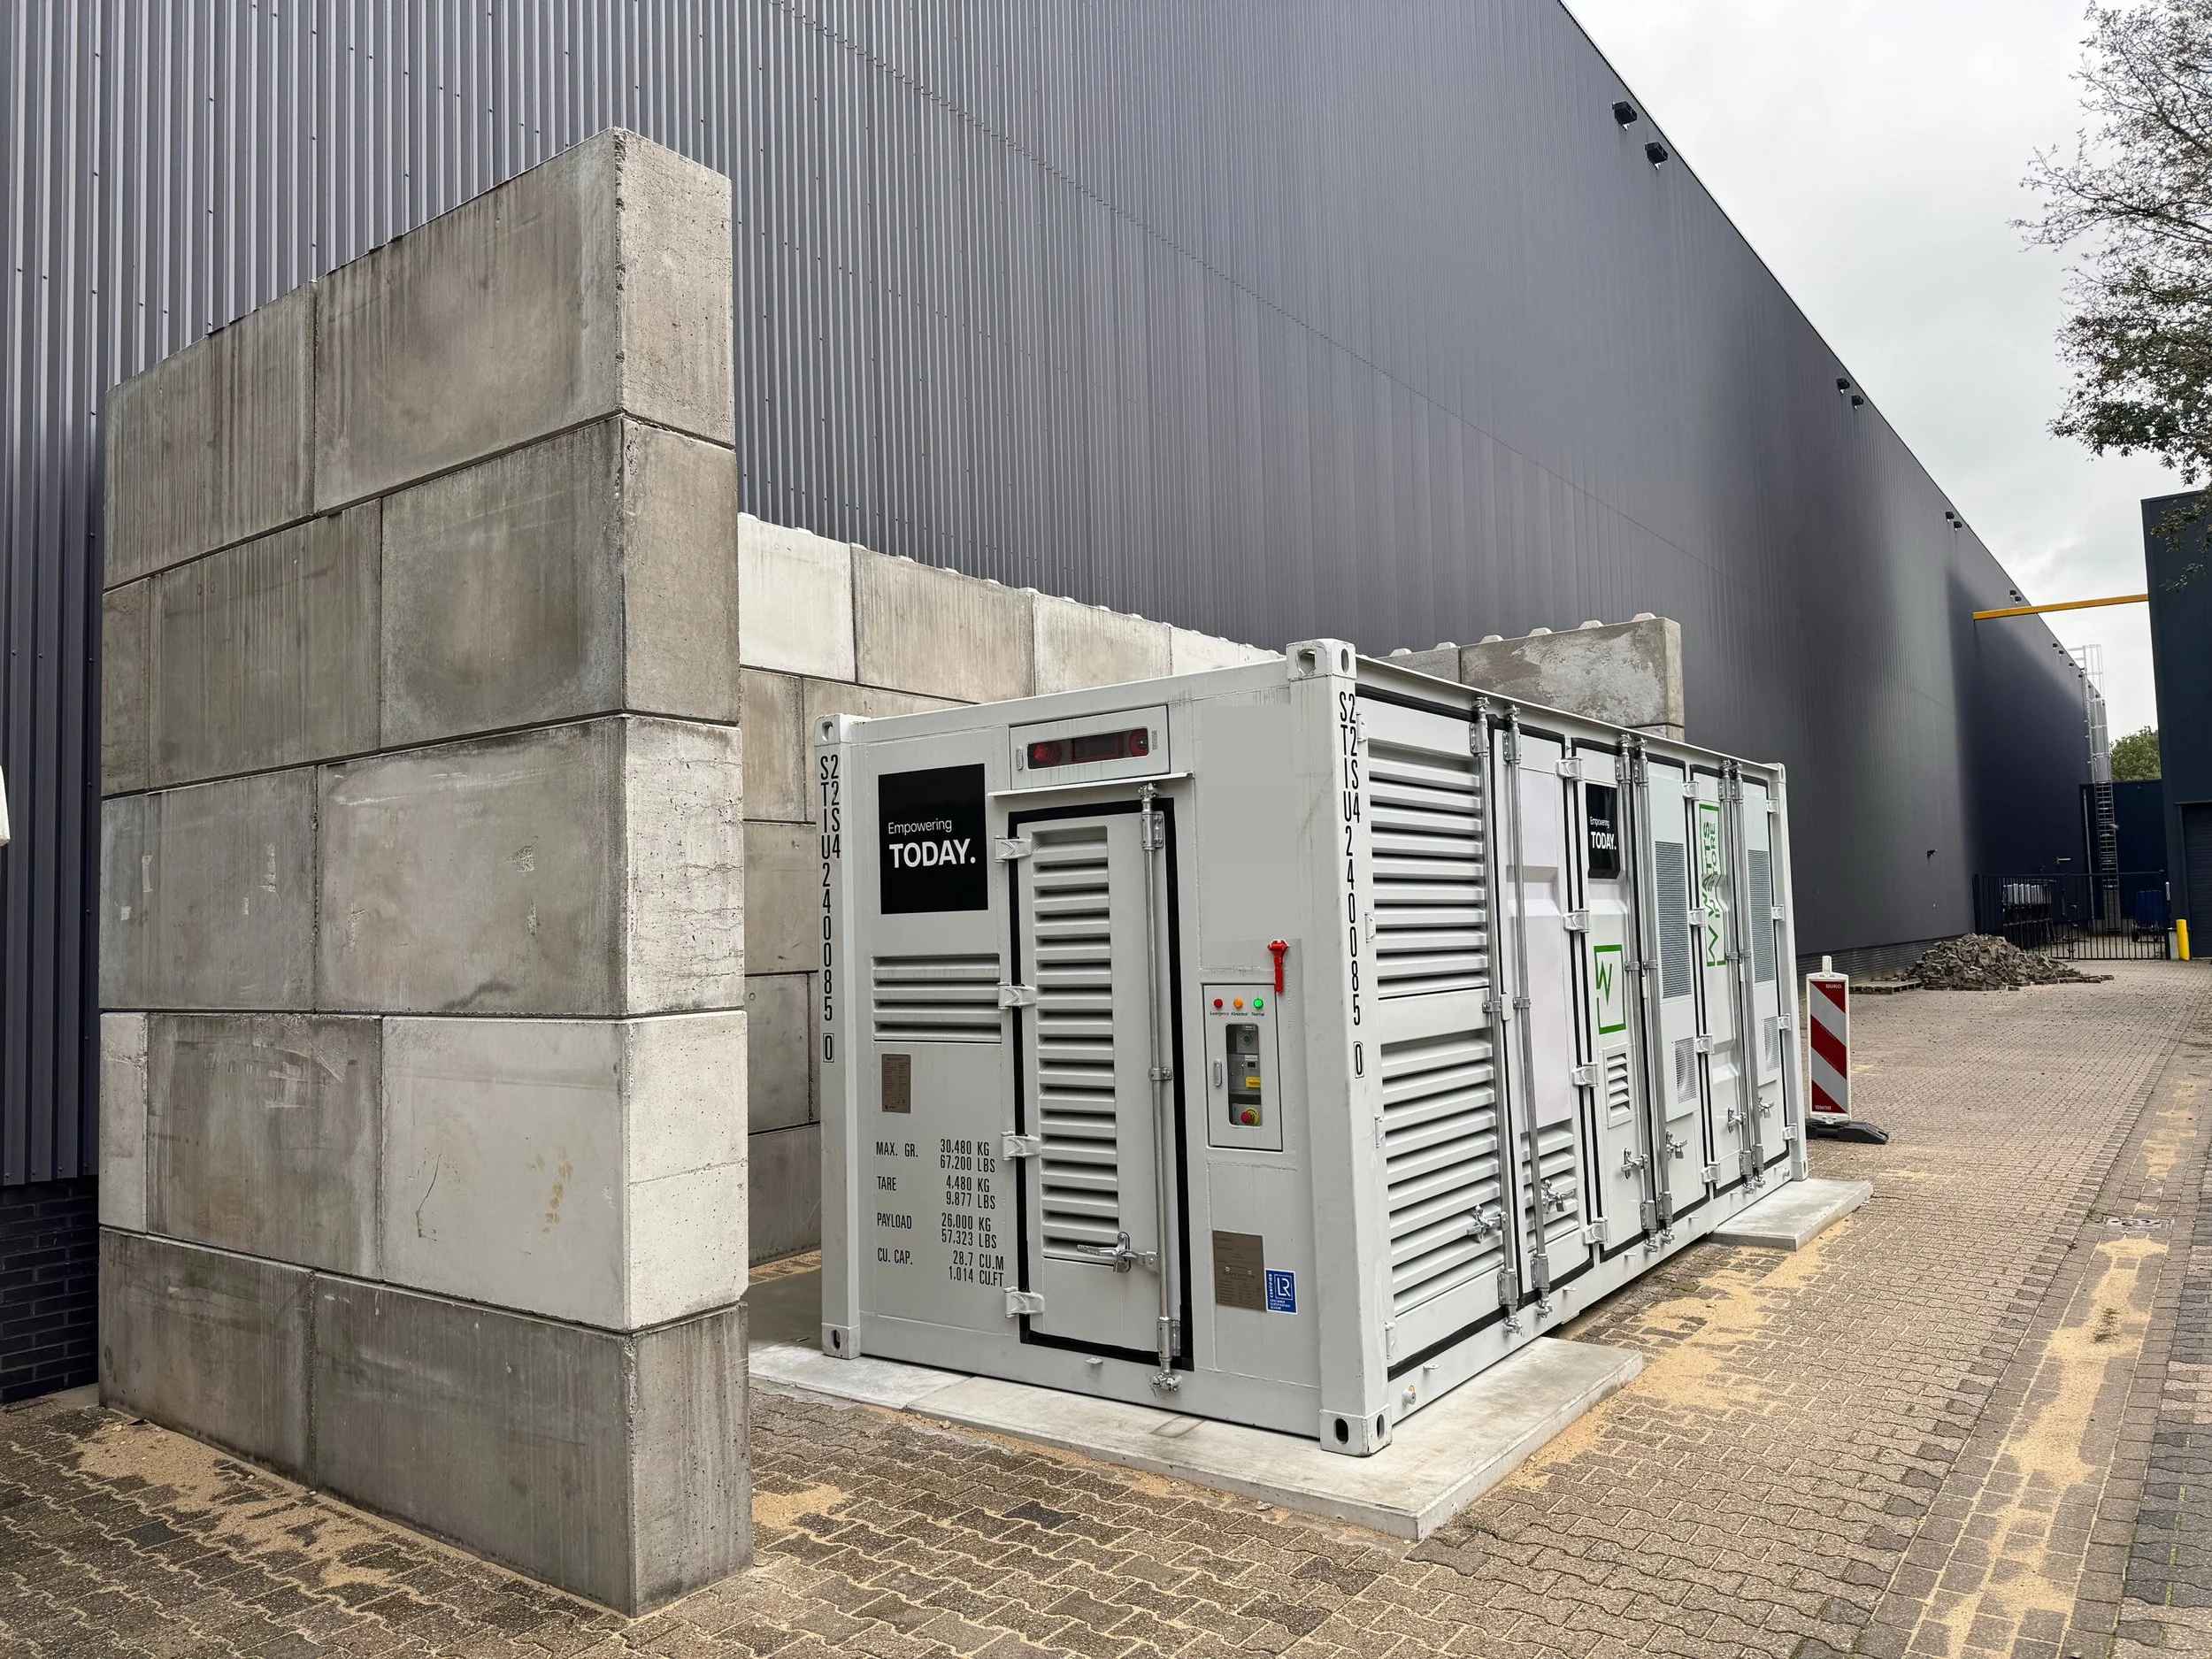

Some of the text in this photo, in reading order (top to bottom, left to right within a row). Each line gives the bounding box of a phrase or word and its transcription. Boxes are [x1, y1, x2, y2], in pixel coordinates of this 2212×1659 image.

[1348, 693, 1361, 824] 22S4
[830, 754, 841, 859] 22S4
[888, 818, 952, 836] Empowering
[1590, 831, 1617, 850] TODAY.
[889, 838, 976, 868] TODAY.
[876, 1141, 898, 1156] MAX.
[904, 1143, 918, 1157] GR.
[977, 1141, 990, 1156] KG
[977, 1157, 995, 1173] LBS
[877, 1176, 897, 1191] TARE
[977, 1178, 990, 1193] KG
[977, 1194, 995, 1210] LBS
[877, 1212, 912, 1230] PAYLOAD
[979, 1217, 991, 1233] KG
[979, 1233, 997, 1248] LBS
[877, 1247, 1004, 1271] CU. CAP. 28.7 CU.M
[979, 1270, 1004, 1286] CU.FT
[1277, 1277, 1291, 1297] LR
